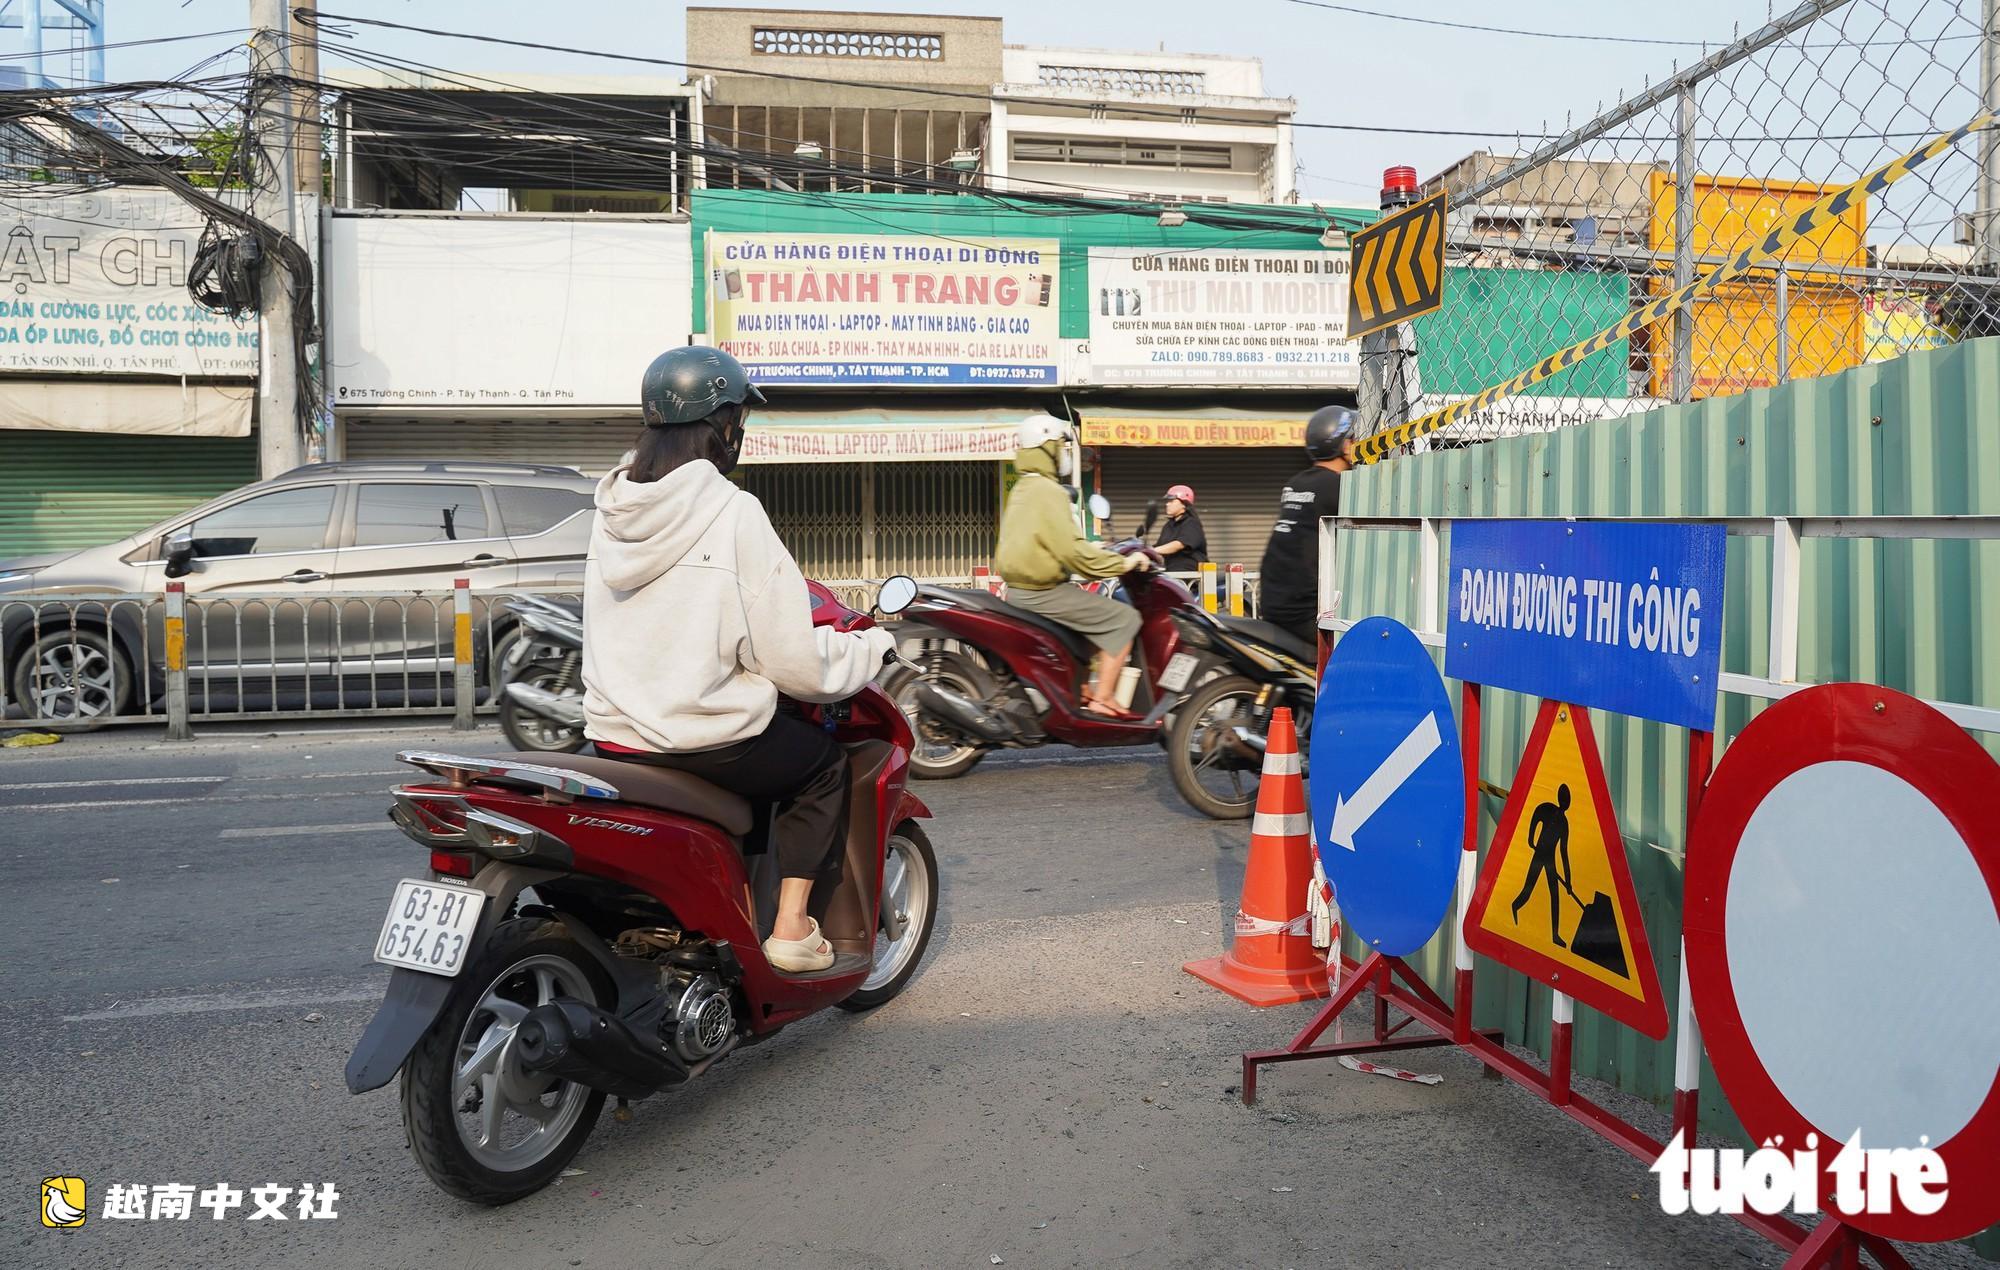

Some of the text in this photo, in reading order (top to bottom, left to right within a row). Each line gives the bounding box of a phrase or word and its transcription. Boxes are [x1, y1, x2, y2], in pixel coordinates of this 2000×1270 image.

[100, 236, 186, 287] CH
[726, 241, 1040, 267] CỬA HÀNG ĐIỆN THOẠI DI ĐỘNG
[1132, 253, 1350, 278] CỬA HÀNG ĐIỆN THOẠI DI ĐỘN
[746, 265, 1021, 307] THÀNH TRANG
[1147, 280, 1197, 314] THU
[1206, 280, 1253, 314] MAI
[737, 314, 762, 331] MUA
[839, 314, 881, 332] LAPTOP
[1009, 318, 1030, 334] CAO
[1151, 321, 1172, 330] MUA
[1254, 322, 1287, 331] LAPTOP
[1295, 322, 1316, 331] IPAD
[237, 331, 259, 348] NG
[1327, 338, 1347, 346] IPAD
[877, 341, 905, 356] THAY
[1151, 351, 1350, 362] ZALO: 090.789.8683 0932.211.218
[10, 353, 37, 366] TÂN
[42, 354, 68, 367] SƠN
[120, 355, 148, 368] TÂN
[743, 366, 758, 377] 77
[802, 366, 836, 378] CHINH,
[838, 366, 848, 376] P.
[849, 364, 870, 376] TÂY
[910, 366, 926, 376] TP.
[927, 366, 949, 376] HCM
[350, 389, 368, 398] 675
[408, 388, 437, 398] Chinh
[1114, 424, 1152, 440] 679
[1157, 425, 1190, 440] MUA
[1460, 563, 1701, 657] ĐOẠN ĐƯỜNG THI CÔNG
[567, 813, 654, 836] VISION
[440, 876, 468, 887] HONDA
[384, 923, 464, 968] 654.63
